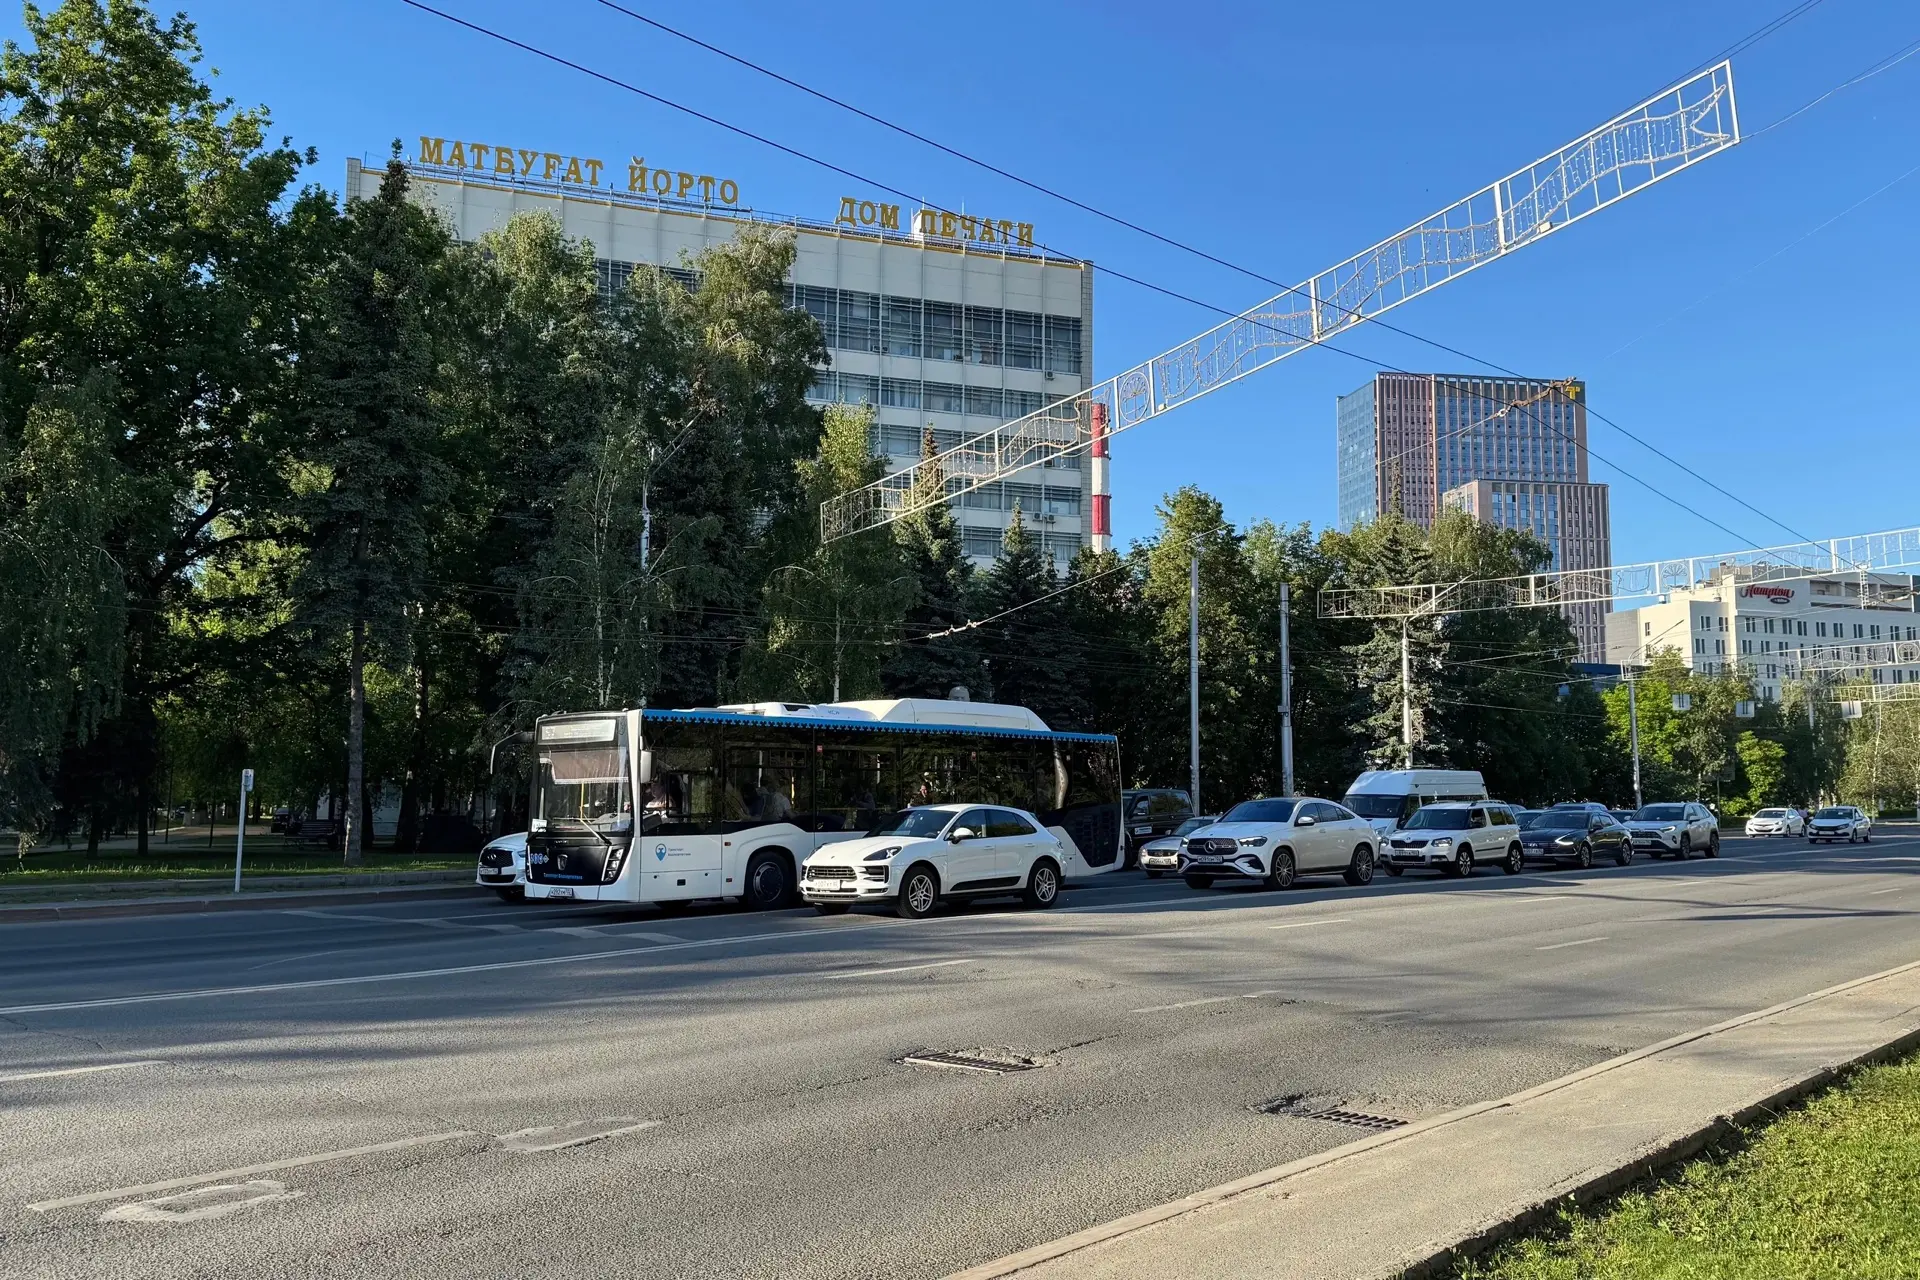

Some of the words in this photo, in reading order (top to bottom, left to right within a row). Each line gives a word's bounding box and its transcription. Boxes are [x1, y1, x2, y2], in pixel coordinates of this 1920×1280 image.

[628, 155, 740, 205] ЙОРТО
[834, 196, 900, 230] ДОМ
[918, 208, 1035, 248] ПЕЧАТИ
[1740, 584, 1795, 598] Hampton
